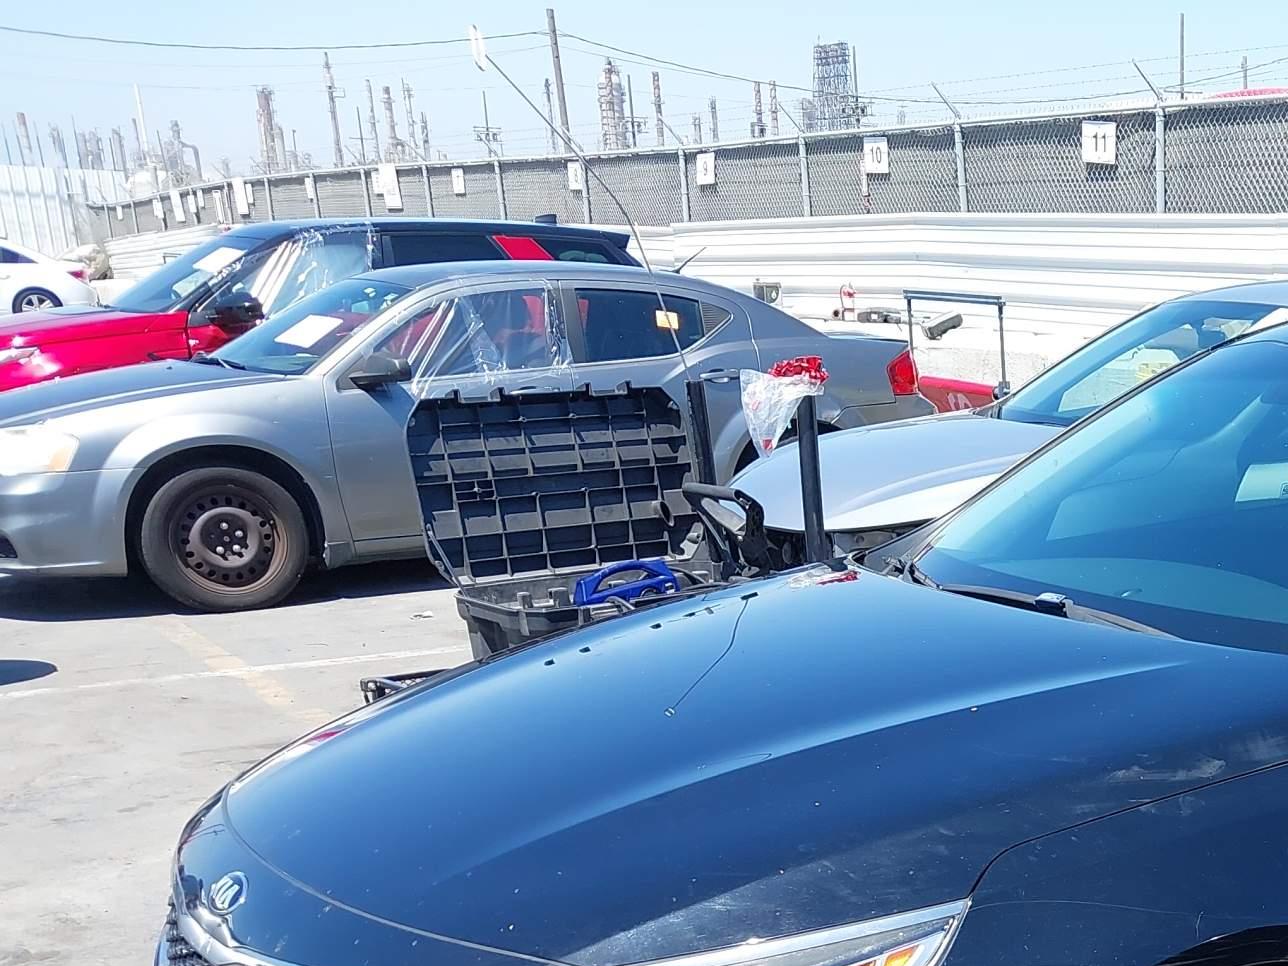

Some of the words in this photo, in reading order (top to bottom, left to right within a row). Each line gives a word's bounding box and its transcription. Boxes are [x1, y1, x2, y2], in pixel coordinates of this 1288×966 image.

[1092, 131, 1106, 152] 11
[870, 145, 882, 164] 10
[702, 160, 708, 177] 9
